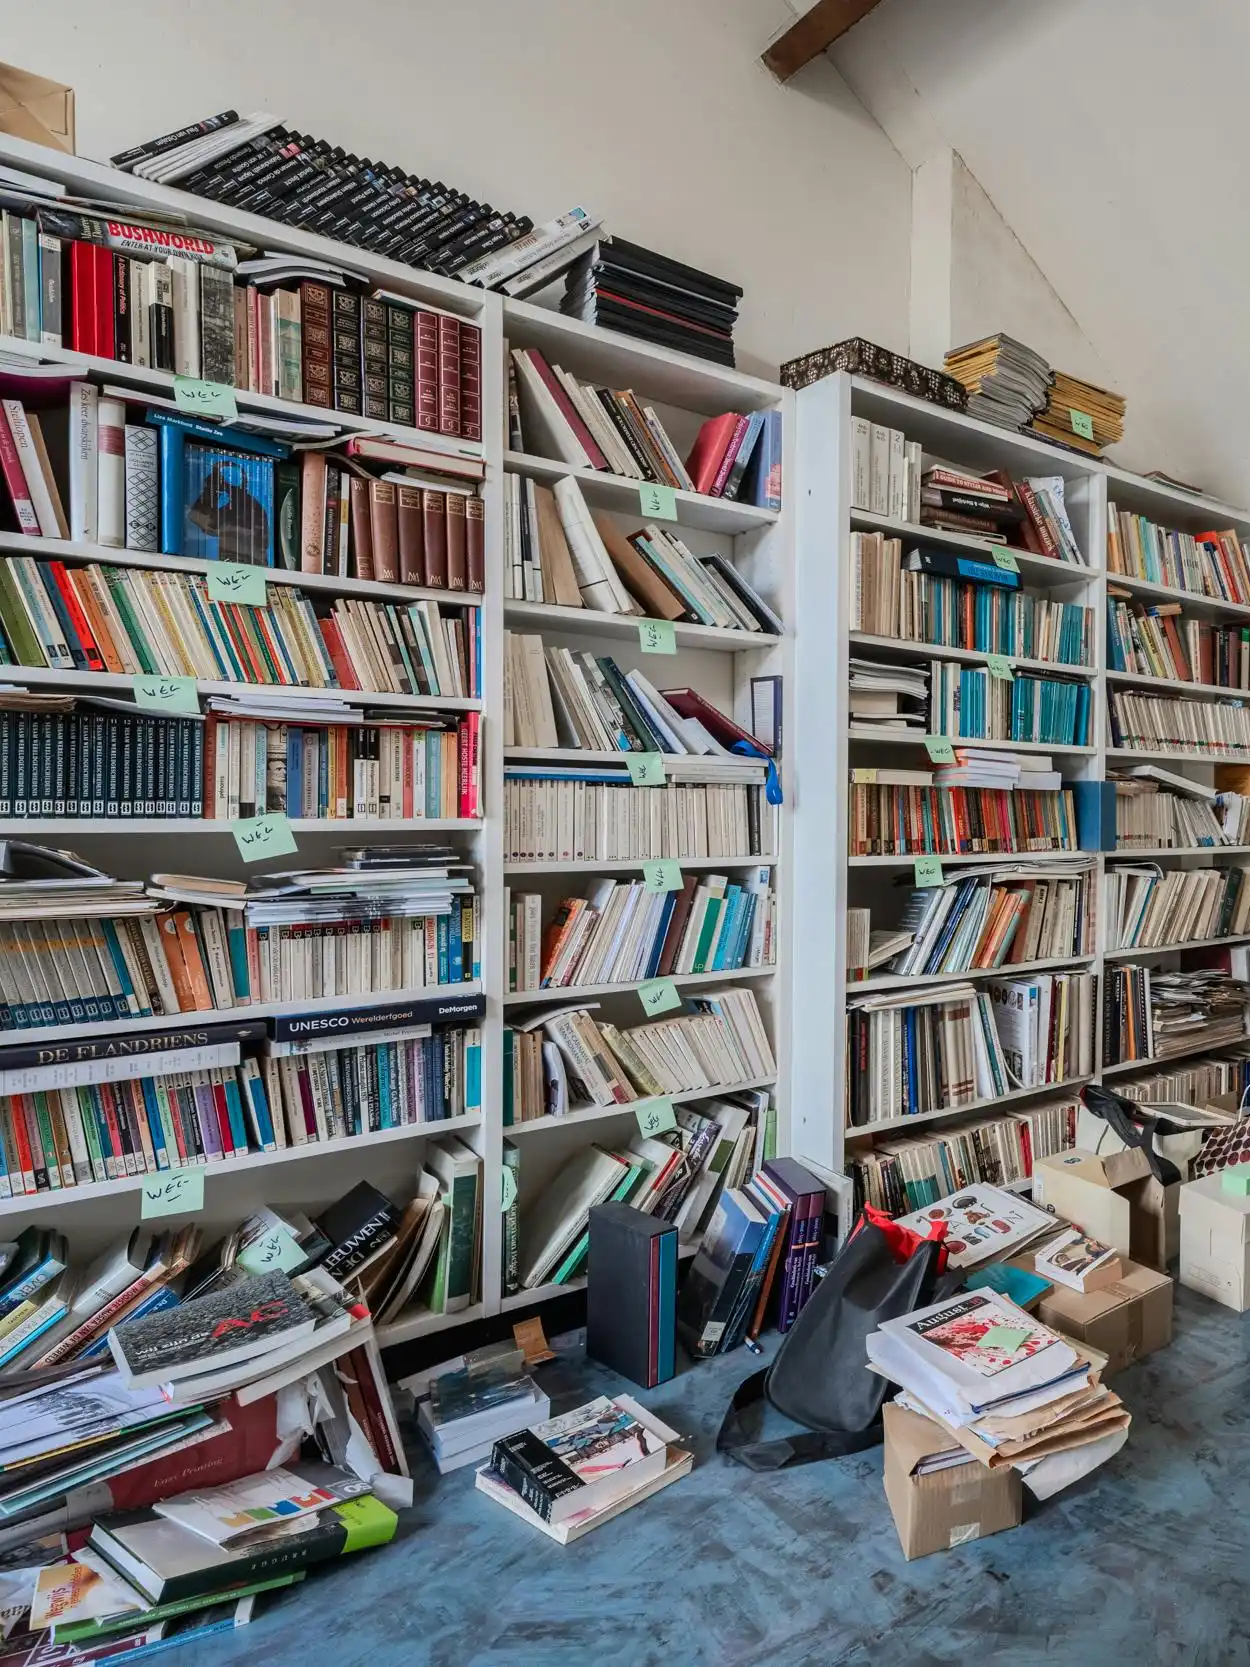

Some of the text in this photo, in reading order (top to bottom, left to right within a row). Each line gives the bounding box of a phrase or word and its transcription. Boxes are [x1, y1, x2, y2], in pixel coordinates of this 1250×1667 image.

[107, 221, 215, 255] BUSHWORLD
[121, 240, 140, 250] ENTER
[81, 388, 91, 401] Zes
[1024, 490, 1043, 525] Klassieke
[289, 1003, 478, 1032] UNESCO Werelderfgoed DeMorgen
[37, 1032, 210, 1065] DE FLANDRIENS
[917, 1303, 968, 1331] August
[44, 1586, 67, 1620] Wegwijs
